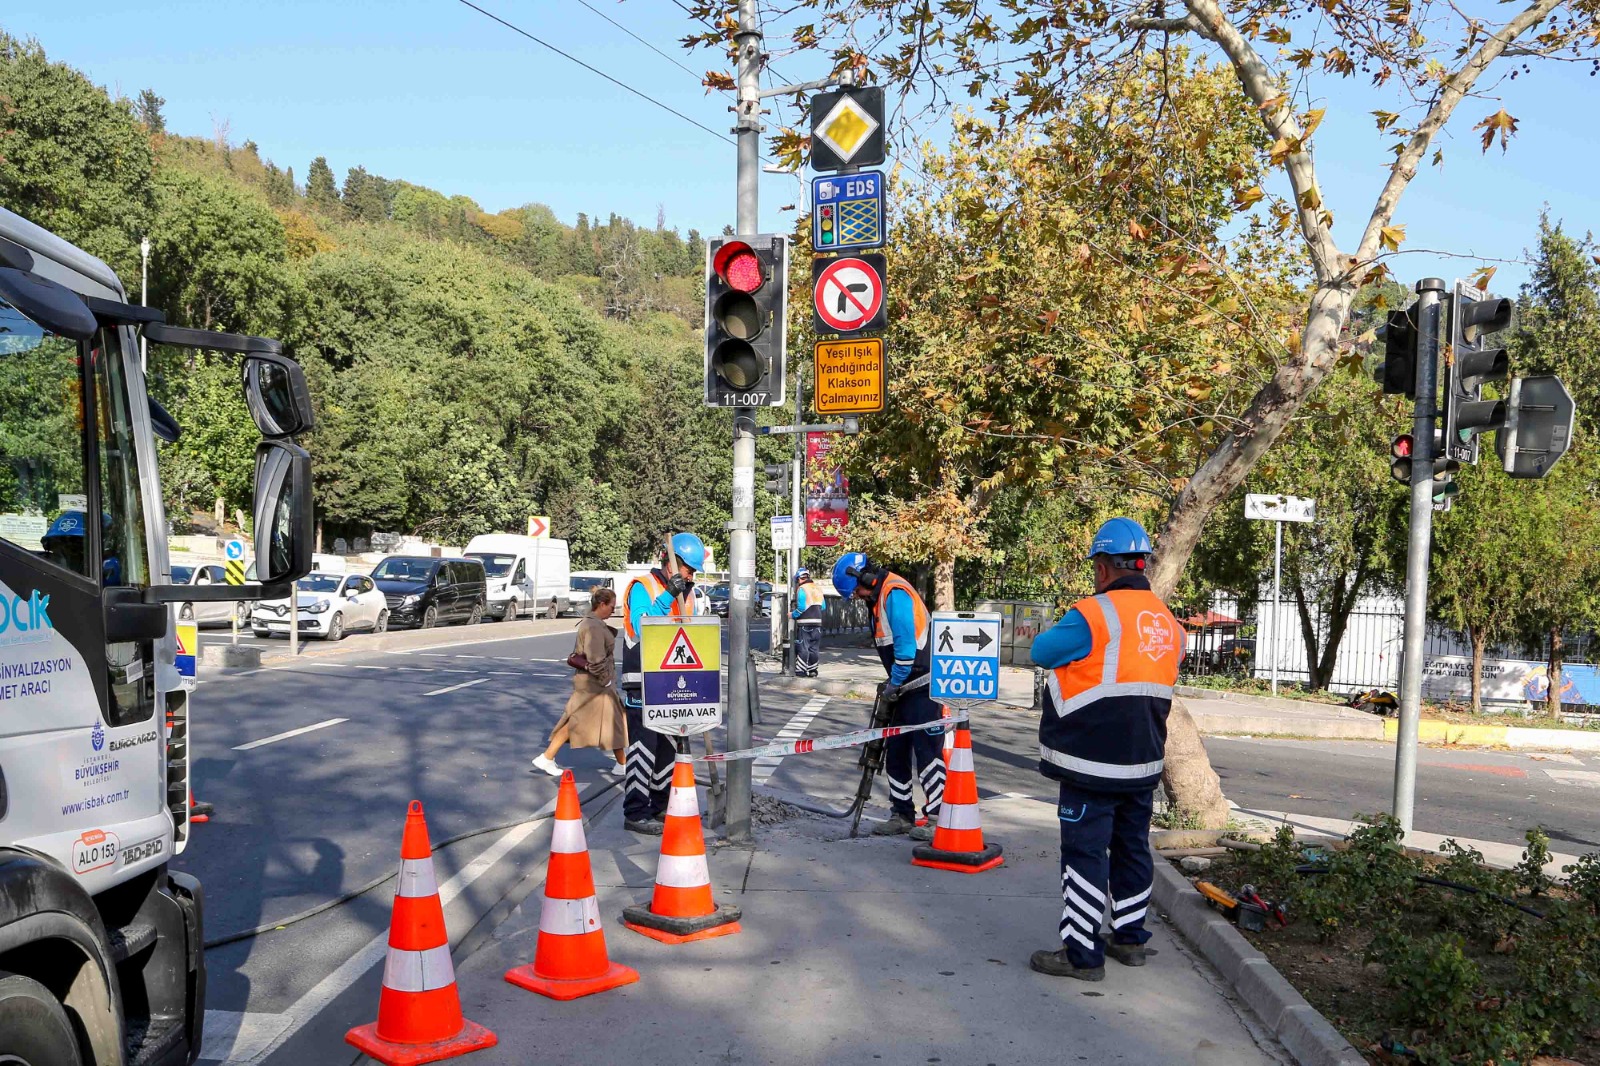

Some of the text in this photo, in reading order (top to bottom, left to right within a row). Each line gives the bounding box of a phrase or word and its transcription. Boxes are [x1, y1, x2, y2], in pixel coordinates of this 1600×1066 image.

[846, 179, 875, 197] EDS
[826, 346, 872, 360] Yeşil Işık
[820, 361, 878, 375] Yandığında
[828, 378, 871, 388] Klakson
[723, 393, 767, 406] 11-007
[821, 393, 878, 406] Çalmayınız
[1454, 446, 1471, 461] 11-007
[0, 658, 72, 680] İNYALIZASYON
[938, 659, 993, 676] YAYA
[20, 680, 51, 697] ARACI
[936, 678, 994, 696] YOLU
[648, 708, 716, 720] ÇALIŞMA VAR
[109, 731, 157, 751] EUROCARGO
[75, 758, 120, 780] BÜYÜKŞEHİR
[61, 789, 130, 815] www.isbak.com.tr
[79, 843, 115, 867] ALO 153
